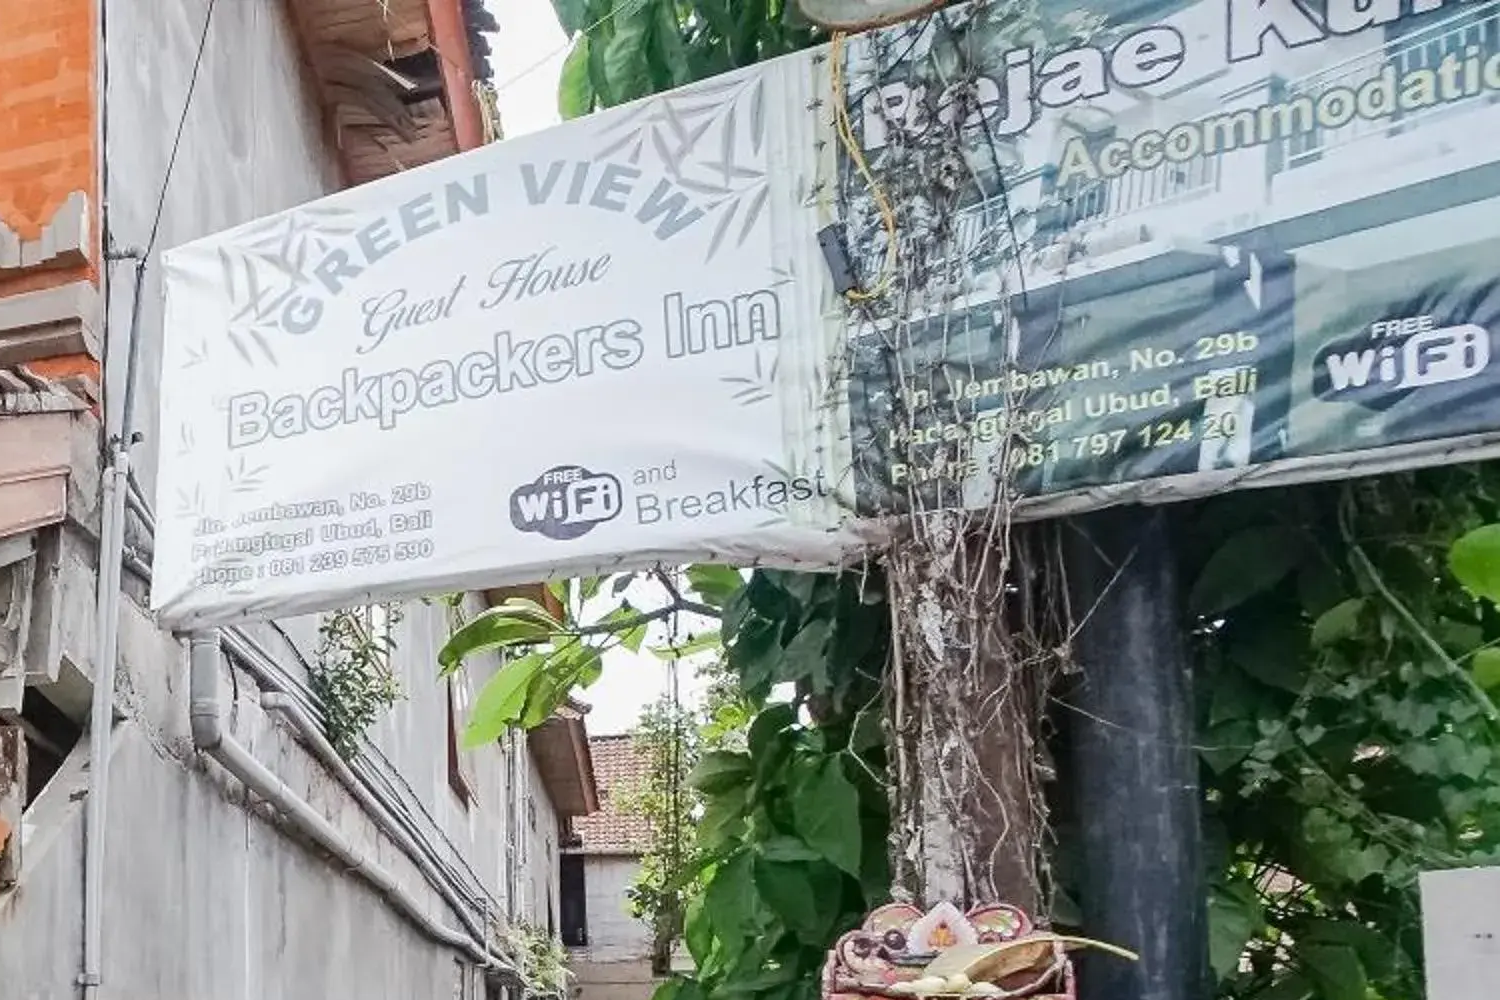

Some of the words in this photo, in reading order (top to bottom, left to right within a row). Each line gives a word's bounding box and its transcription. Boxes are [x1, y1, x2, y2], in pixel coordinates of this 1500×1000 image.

[281, 174, 490, 335] GREEN
[519, 159, 707, 241] VIEW
[356, 275, 468, 355] Guest
[480, 245, 612, 310] House
[1371, 314, 1434, 341] FREE
[227, 318, 645, 449] Backpackers
[664, 288, 782, 359] Inn
[1130, 348, 1184, 373] No.
[1195, 330, 1259, 360] 29b
[1085, 384, 1179, 418] Ubud,
[1194, 367, 1259, 401] Bali
[1075, 430, 1127, 459] 797
[1139, 417, 1192, 448] 124
[544, 470, 584, 486] FREE
[632, 459, 677, 488] and
[350, 491, 387, 512] No.
[391, 482, 431, 505] 29b
[636, 467, 829, 525] Breakfast
[321, 518, 384, 543] Ubud,
[390, 509, 433, 533] Bali
[197, 564, 254, 588] hone
[269, 558, 304, 577] 081
[309, 550, 349, 572] 239
[352, 544, 391, 566] 575
[395, 538, 434, 561] 590
